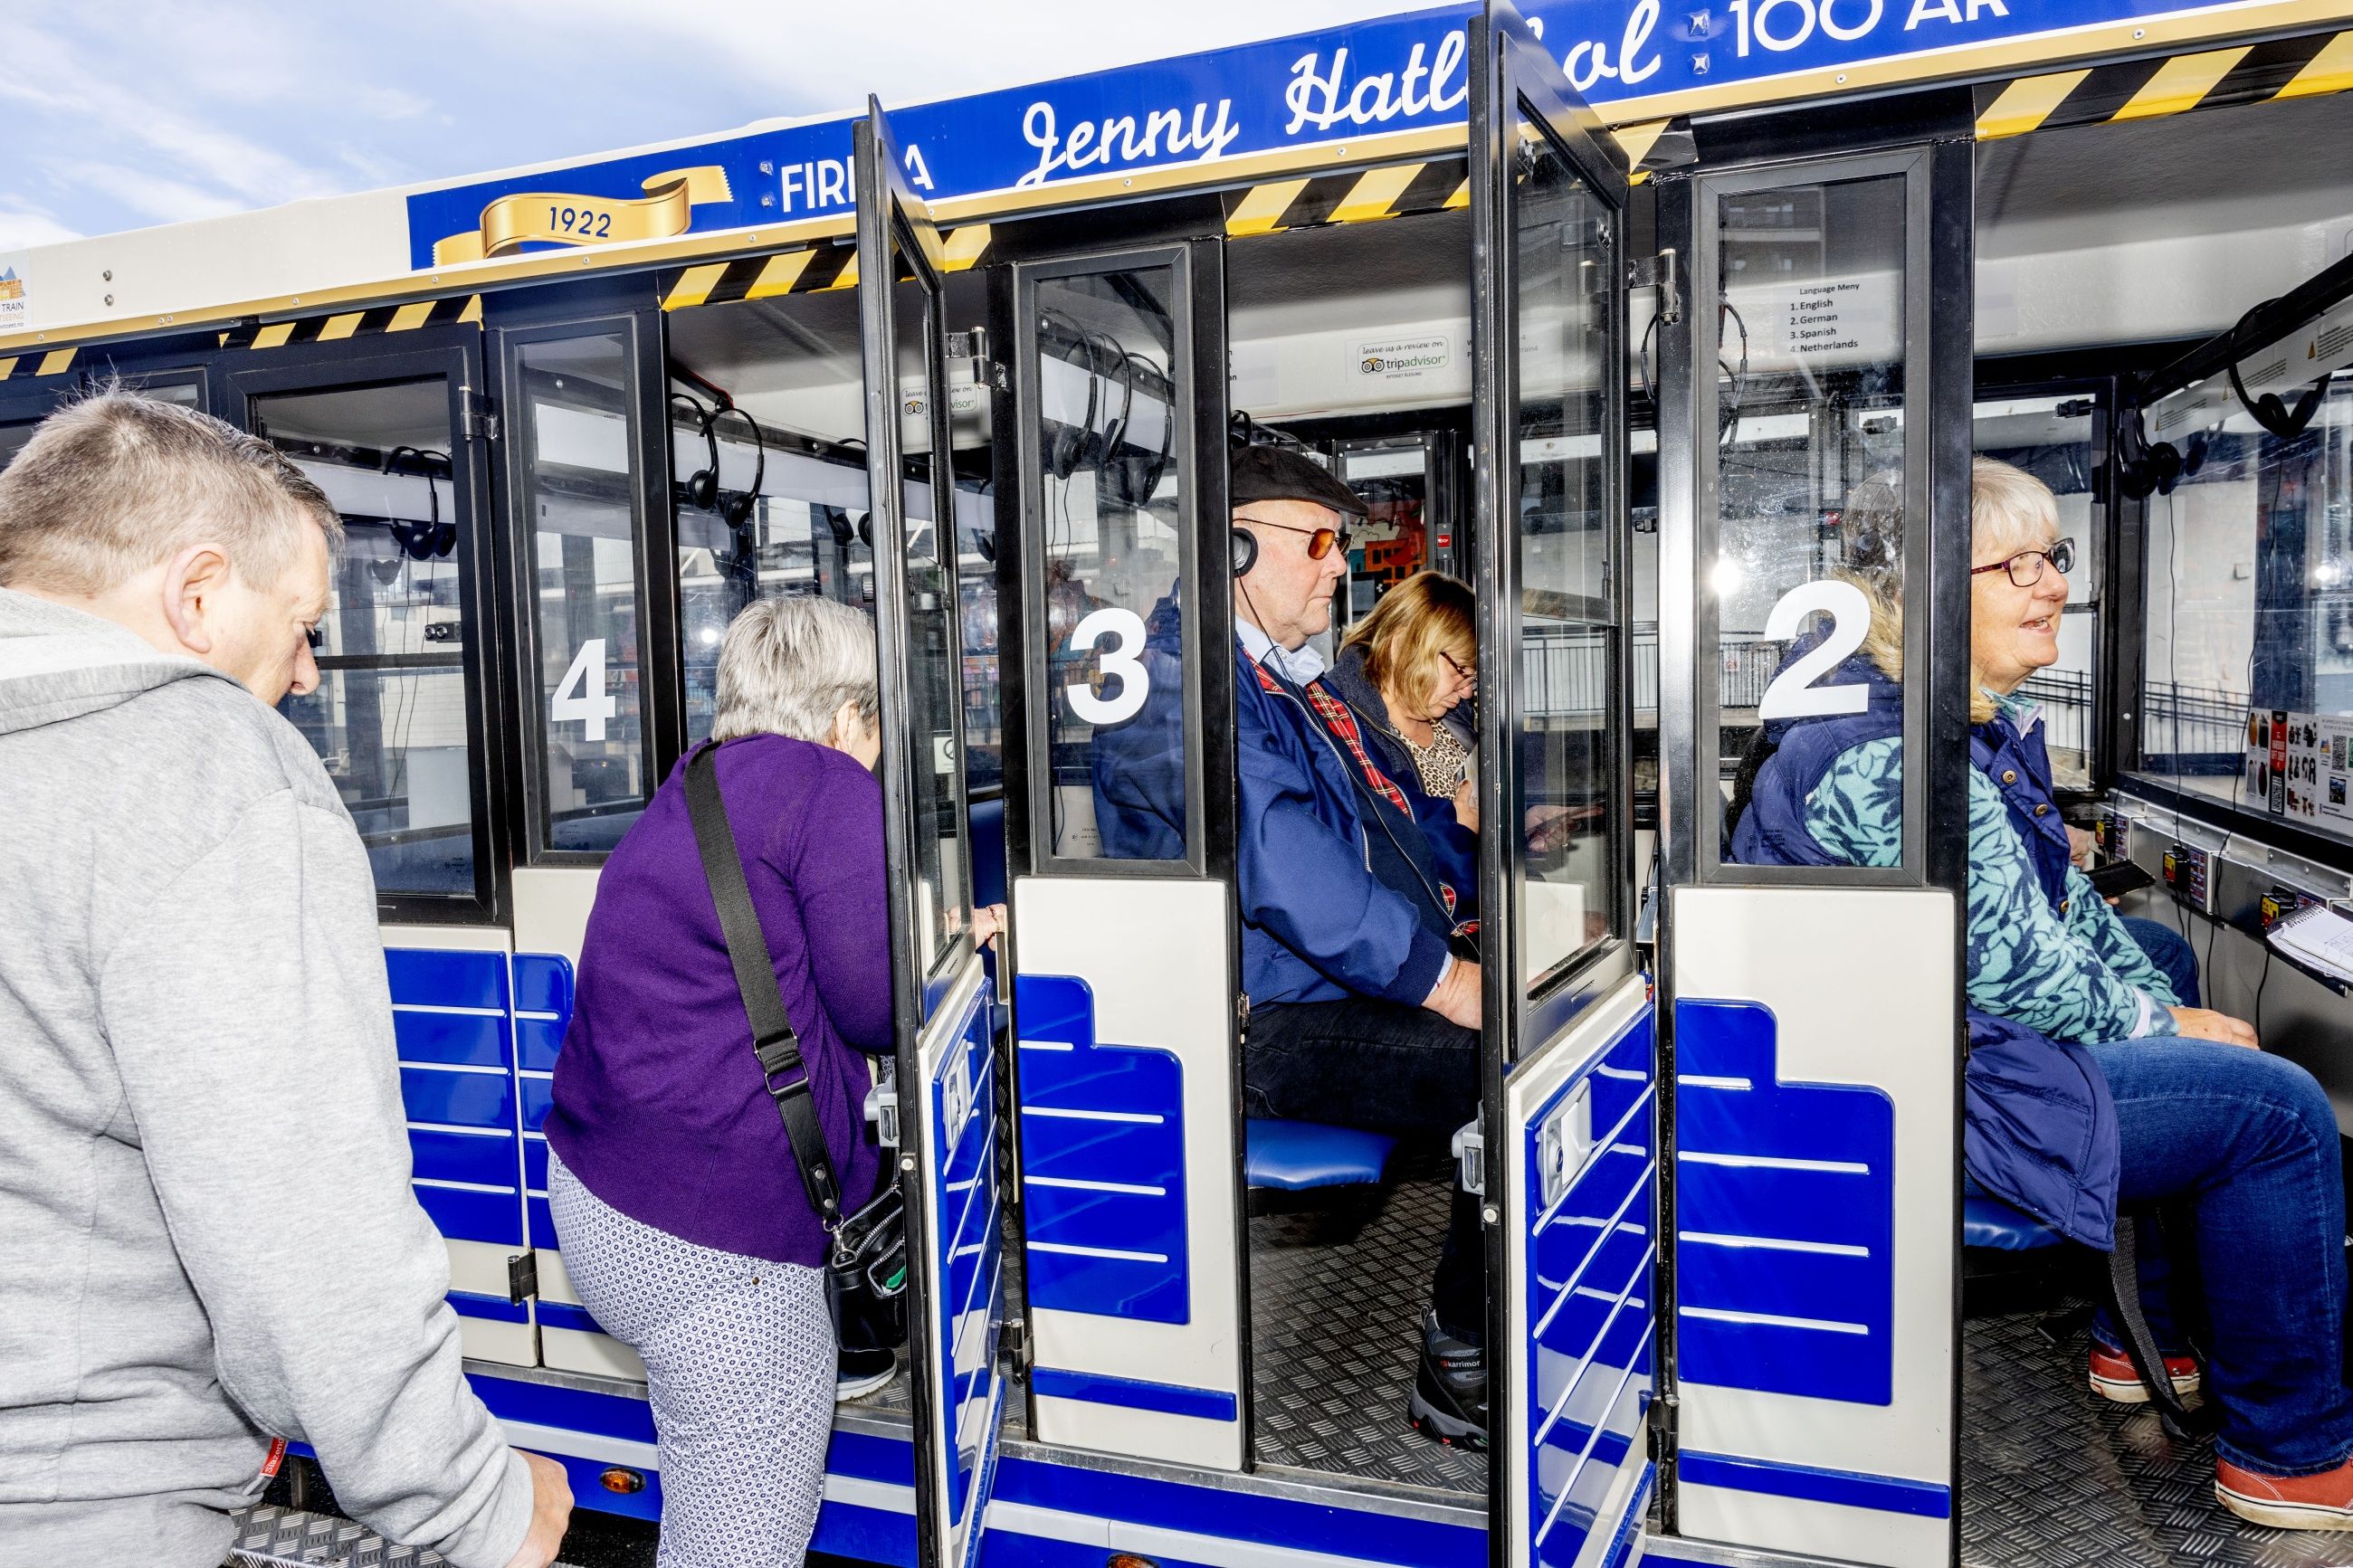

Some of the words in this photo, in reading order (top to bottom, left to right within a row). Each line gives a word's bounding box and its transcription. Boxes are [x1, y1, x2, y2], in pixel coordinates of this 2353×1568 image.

[781, 144, 934, 213] FIRA
[1015, 99, 1239, 188] Jenny
[1285, 0, 1662, 135] Hatlol
[1729, 0, 1883, 57] 100
[550, 206, 611, 238] 1922
[1799, 286, 1835, 295] Language
[1837, 283, 1860, 291] Meny
[2, 301, 24, 312] TRAIN
[1800, 299, 1833, 310] English
[1800, 314, 1838, 324] German
[1800, 328, 1836, 339] Spanish
[1362, 347, 1384, 355] leave
[1404, 342, 1430, 350] review
[1800, 339, 1858, 352] Netherlands
[1758, 580, 1871, 719] 2
[1067, 608, 1149, 724] 3
[552, 639, 615, 741] 4
